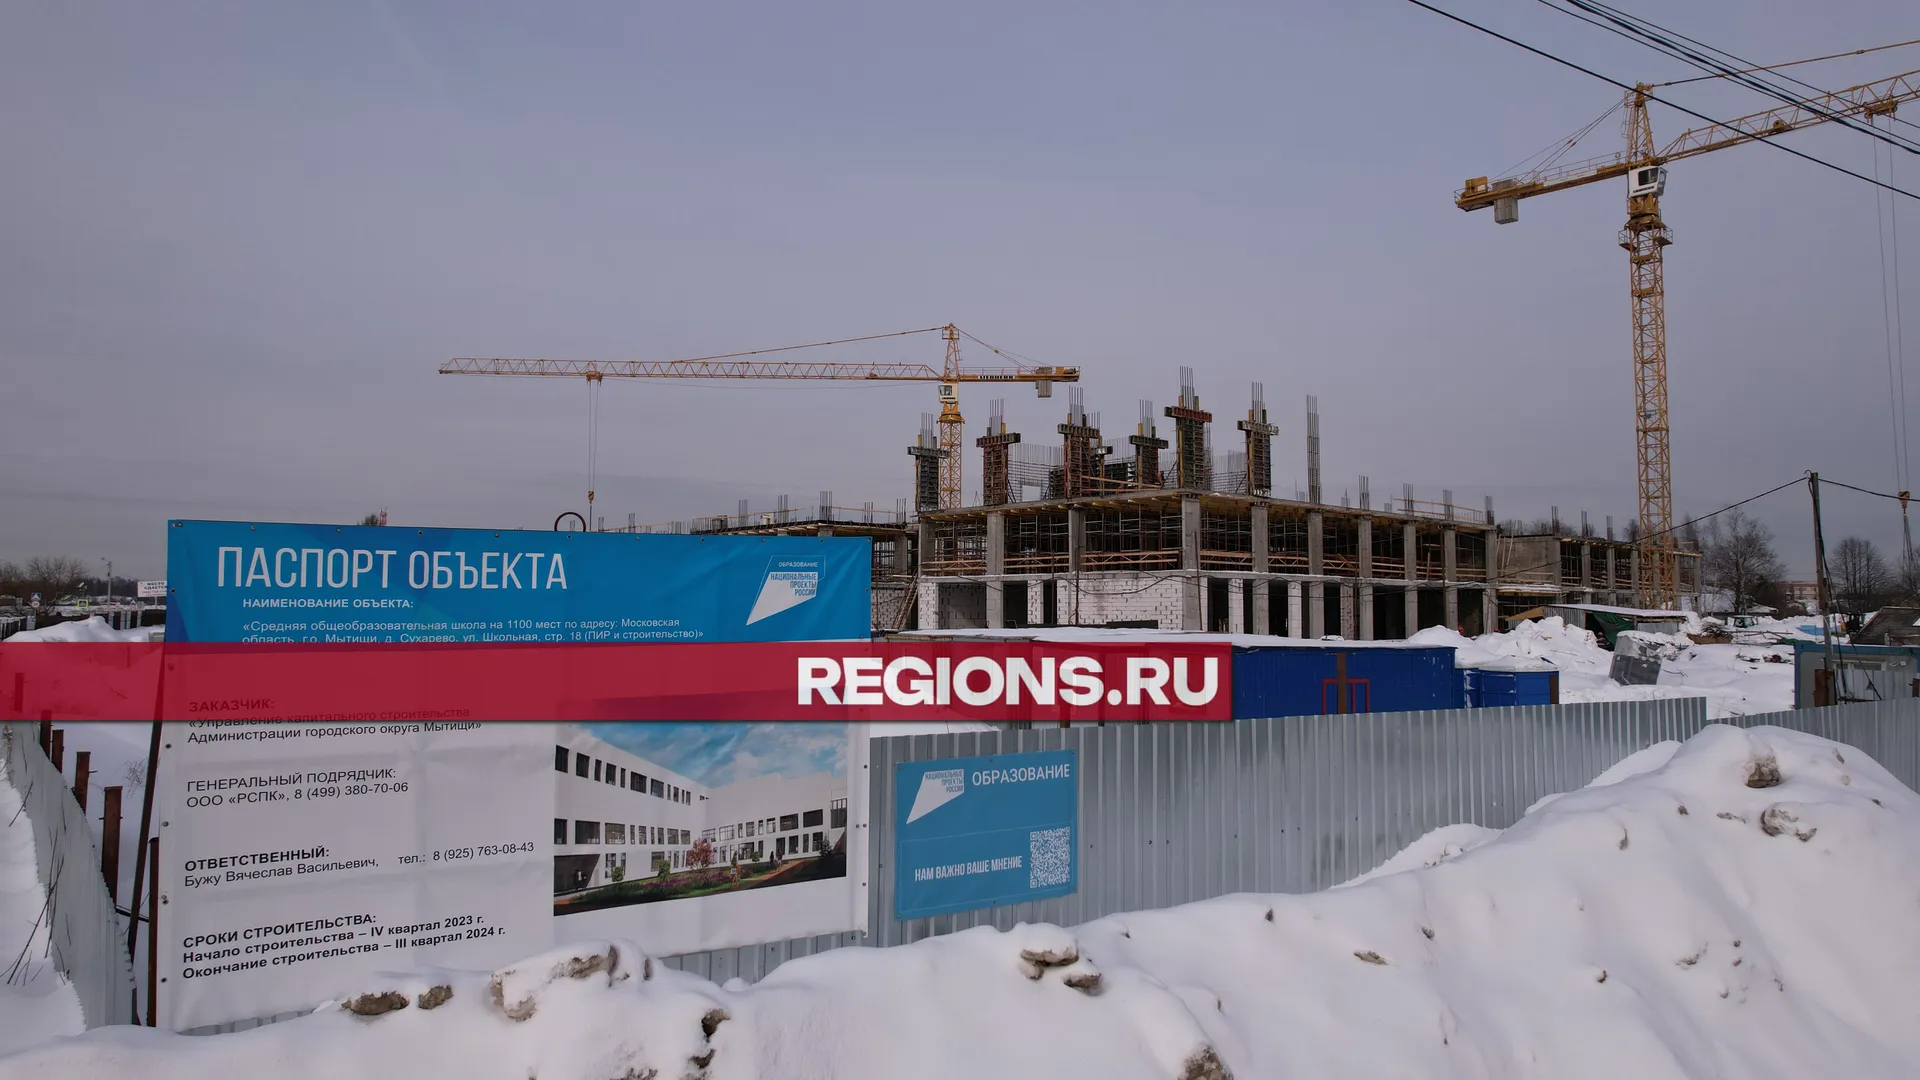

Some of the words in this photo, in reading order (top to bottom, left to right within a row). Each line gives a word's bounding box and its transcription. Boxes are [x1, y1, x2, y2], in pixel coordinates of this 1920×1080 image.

[217, 546, 397, 589] ПАСПОРТ
[408, 550, 568, 590] ОБЪЕКТА
[770, 572, 817, 581] НАЦИОНАЛЬНЫЕ
[789, 580, 817, 589] ПРОЕКТЫ
[794, 588, 817, 596] РОССИИ
[242, 598, 349, 608] НАИМЕНОВАНИЕ
[353, 599, 414, 609] ОБЪЕКТА:
[242, 634, 297, 643] область
[463, 634, 478, 643] ул.
[482, 632, 541, 642] Школьная,
[545, 633, 566, 642] стр.
[570, 632, 582, 641] 18
[584, 631, 611, 642] (ПИР
[622, 629, 704, 642] строительство)»
[243, 619, 307, 632] «Средняя
[310, 620, 448, 632] общеобразовательная
[451, 620, 486, 630] школа
[489, 621, 503, 630] на
[507, 619, 533, 629] 1100
[535, 621, 561, 629] мест
[564, 621, 578, 629] по
[580, 619, 618, 630] адресу:
[621, 617, 680, 628] Московская
[188, 698, 275, 713] ЗАКАЗЧИК:
[286, 711, 377, 723] капитального
[380, 708, 470, 721] строительства
[187, 727, 301, 744] Администрации
[305, 725, 376, 738] городского
[379, 722, 420, 736] округа
[424, 721, 481, 732] Мытищи»
[187, 772, 302, 792] ГЕНЕРАЛЬНЫЙ
[306, 767, 397, 784] ПОДРЯДЧИК:
[971, 763, 1071, 787] ОБРАЗОВАНИЕ
[186, 794, 224, 808] ООО
[228, 790, 290, 804] «РСПК»,
[294, 788, 303, 800] 8
[306, 785, 341, 801] (499)
[344, 781, 409, 797] 380-70-06
[184, 845, 330, 872] ОТВЕТСТВЕННЫЙ:
[184, 873, 222, 889] Бужу
[225, 866, 293, 883] Вячеслав
[297, 858, 379, 875] Васильевич,
[398, 853, 426, 865] тел.:
[432, 850, 441, 861] 8
[443, 847, 474, 862] (925)
[477, 841, 535, 858] 763-08-43
[914, 867, 934, 882] НАМ
[935, 862, 965, 880] ВАЖНО
[966, 859, 990, 875] ВАШЕ
[991, 855, 1022, 872] МНЕНИЕ
[183, 930, 239, 949] СРОКИ
[243, 913, 376, 940] СТРОИТЕЛЬСТВА:
[183, 947, 241, 964] Начало
[245, 931, 355, 954] строительства
[371, 926, 384, 937] IV
[388, 920, 441, 936] квартал
[444, 915, 473, 929] 2023
[476, 915, 485, 924] г.
[182, 958, 268, 979] Окончание
[272, 942, 379, 965] строительства
[395, 938, 407, 949] III
[411, 931, 463, 947] квартал
[465, 926, 495, 940] 2024
[498, 926, 506, 936] г.
